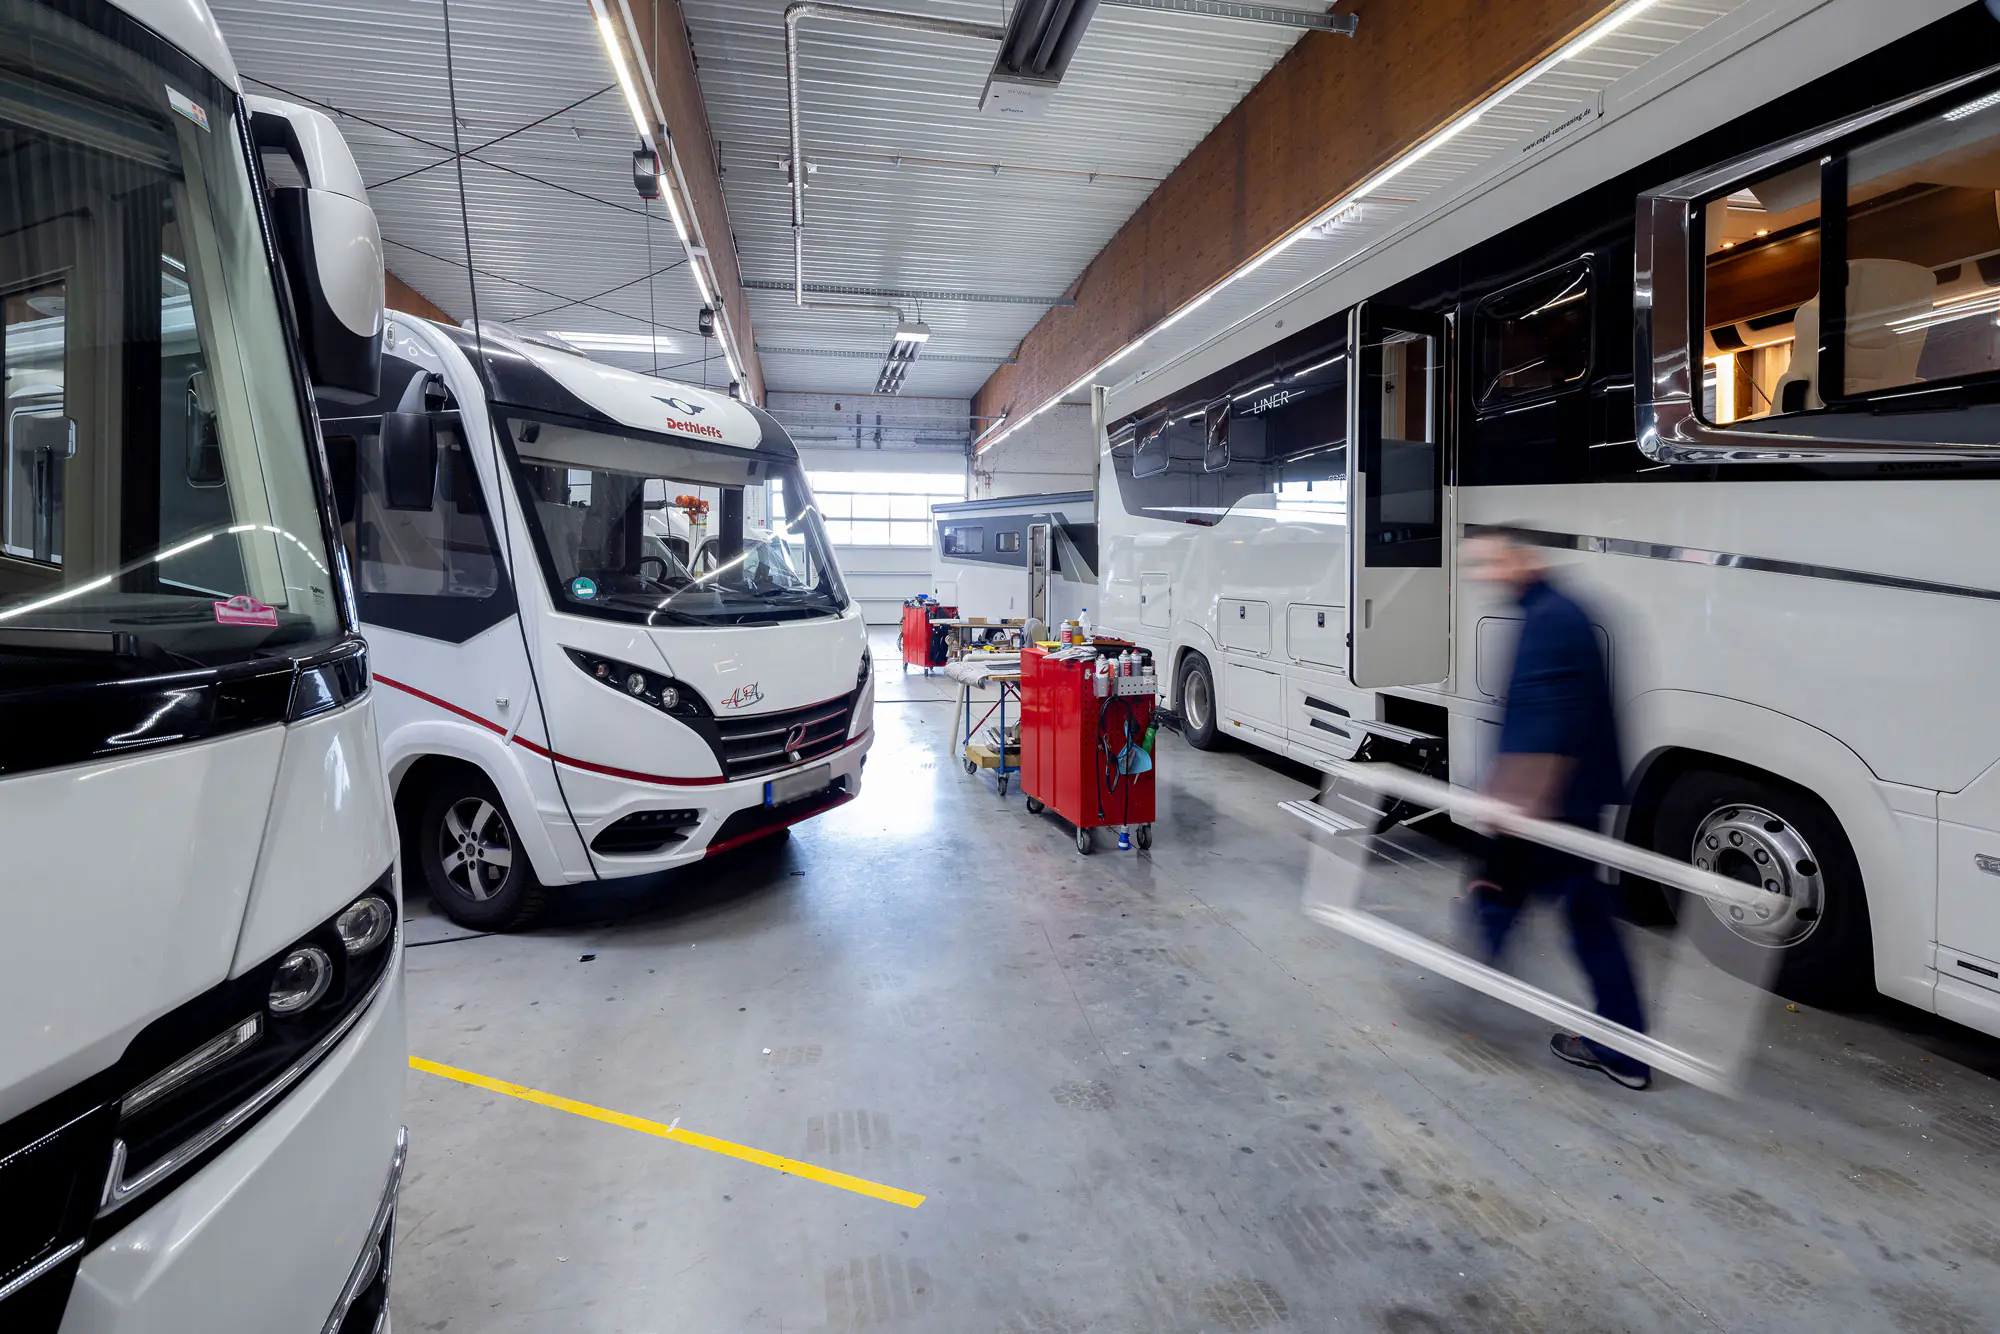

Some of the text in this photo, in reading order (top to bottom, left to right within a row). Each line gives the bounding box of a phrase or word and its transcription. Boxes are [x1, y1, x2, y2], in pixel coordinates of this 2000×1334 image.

[1522, 108, 1591, 153] www.engel-caravaning.de
[1254, 390, 1289, 414] LINER
[666, 417, 723, 439] Dethleffs
